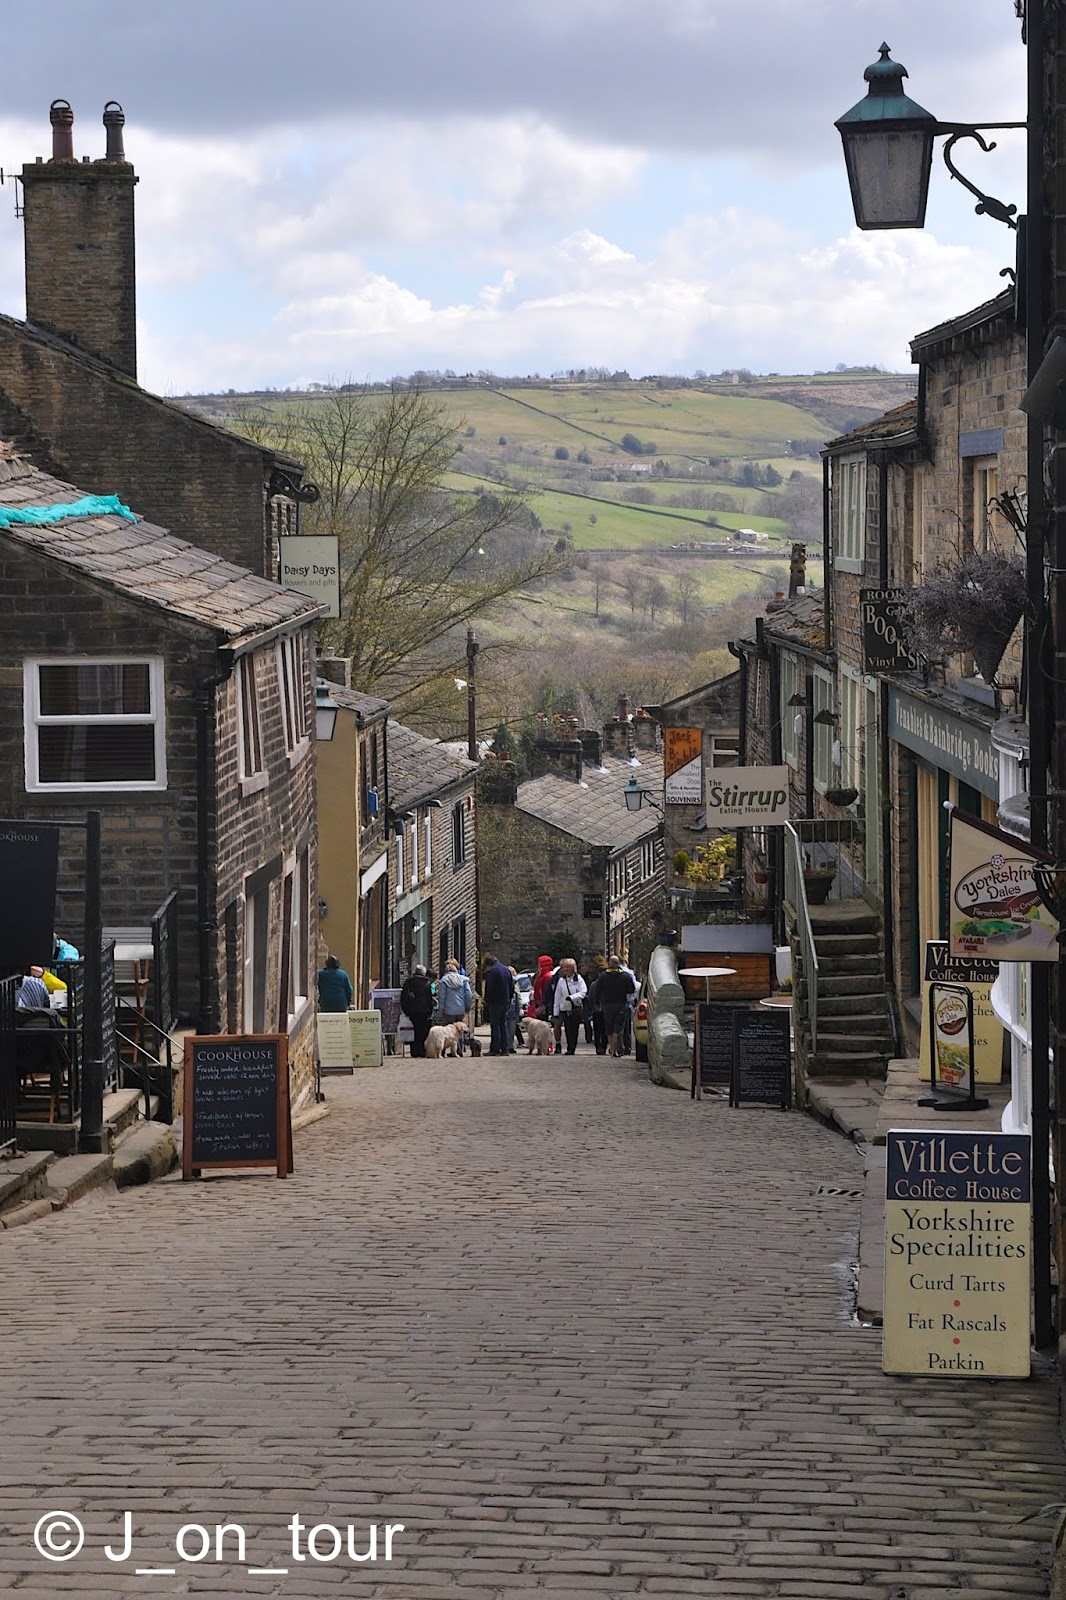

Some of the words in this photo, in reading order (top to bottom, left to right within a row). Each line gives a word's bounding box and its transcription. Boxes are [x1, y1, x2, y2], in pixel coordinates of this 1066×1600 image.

[284, 565, 309, 577] Daisy
[312, 564, 336, 577] Days
[322, 579, 336, 587] gifts
[867, 590, 904, 600] BOOK
[868, 656, 895, 668] Vinyl
[895, 697, 923, 738] Venables
[929, 715, 971, 772] Bainbridge
[973, 737, 999, 781] Books
[709, 785, 787, 812] Stirrup
[720, 806, 743, 815] Eating
[0, 833, 38, 842] OKHOUSE
[986, 885, 1021, 900] Dales
[972, 907, 1009, 918] Farmhouse
[1010, 906, 1020, 914] Ice
[958, 937, 985, 945] AVAILABLE
[929, 968, 965, 981] Coffee
[365, 1016, 380, 1024] Days
[197, 1050, 273, 1062] COOKHOUSE
[895, 1137, 1023, 1175] Villette
[894, 1179, 958, 1198] Coffee
[965, 1180, 1022, 1200] House
[901, 1208, 1015, 1233] Yorkshire
[890, 1233, 1026, 1265] Specialities
[909, 1273, 954, 1291] Curd
[960, 1274, 1006, 1292] Tarts
[907, 1312, 934, 1330] Fat
[942, 1313, 1007, 1332] Rascals
[927, 1352, 985, 1371] Parkin
